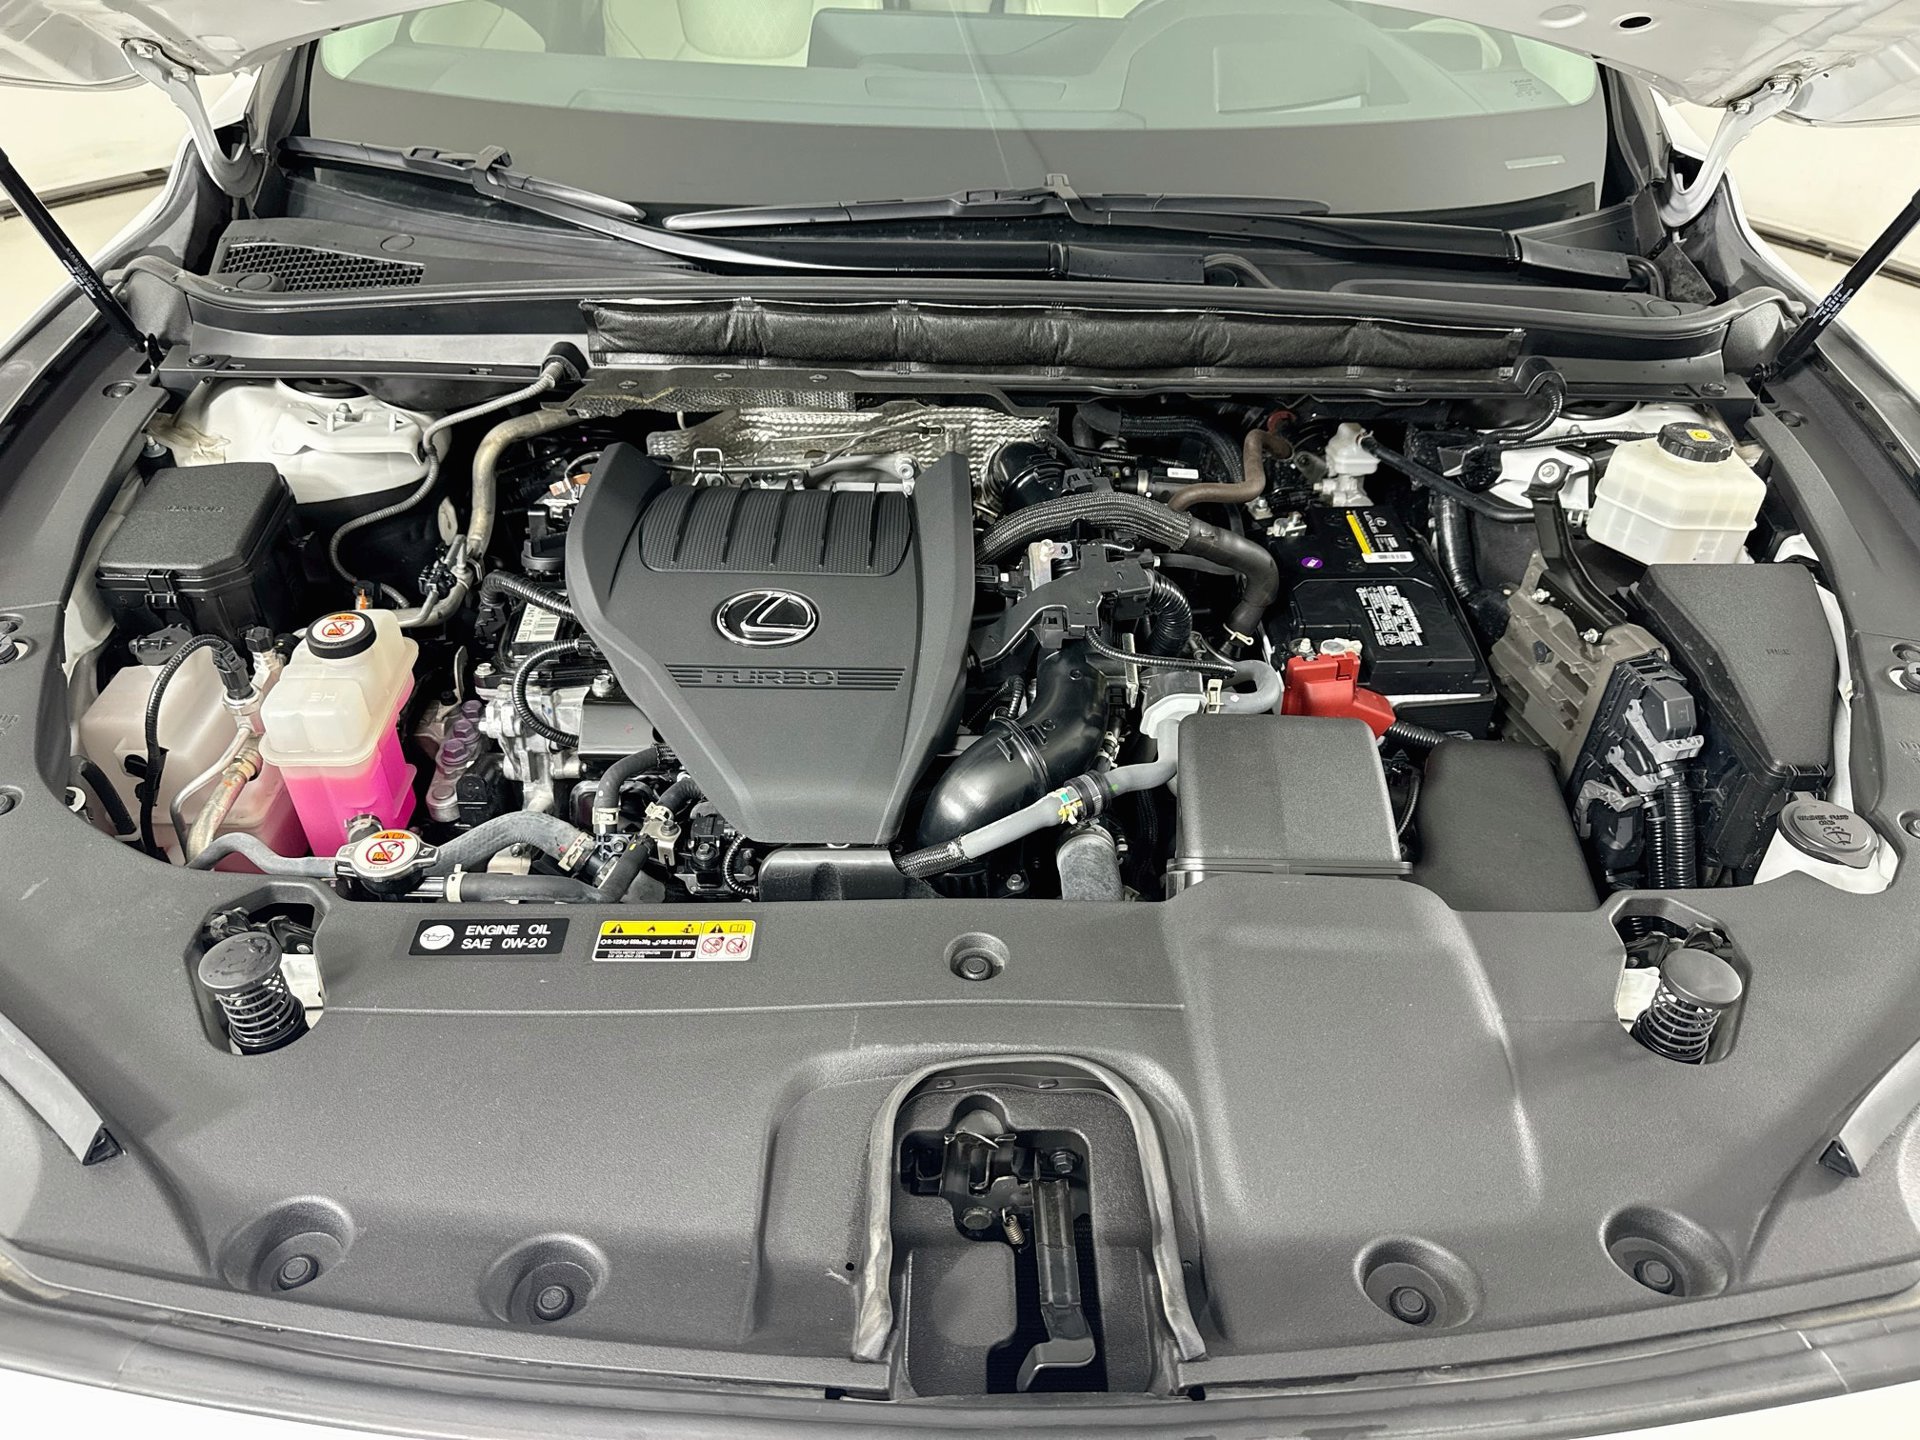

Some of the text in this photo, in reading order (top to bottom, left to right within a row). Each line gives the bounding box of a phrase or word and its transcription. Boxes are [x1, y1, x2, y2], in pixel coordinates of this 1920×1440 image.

[65, 247, 90, 276] STABILUS
[1362, 511, 1379, 534] LEXUS
[707, 669, 835, 686] TURBO
[465, 923, 552, 935] ENGINE OIL
[461, 937, 548, 950] SAE 0W-20
